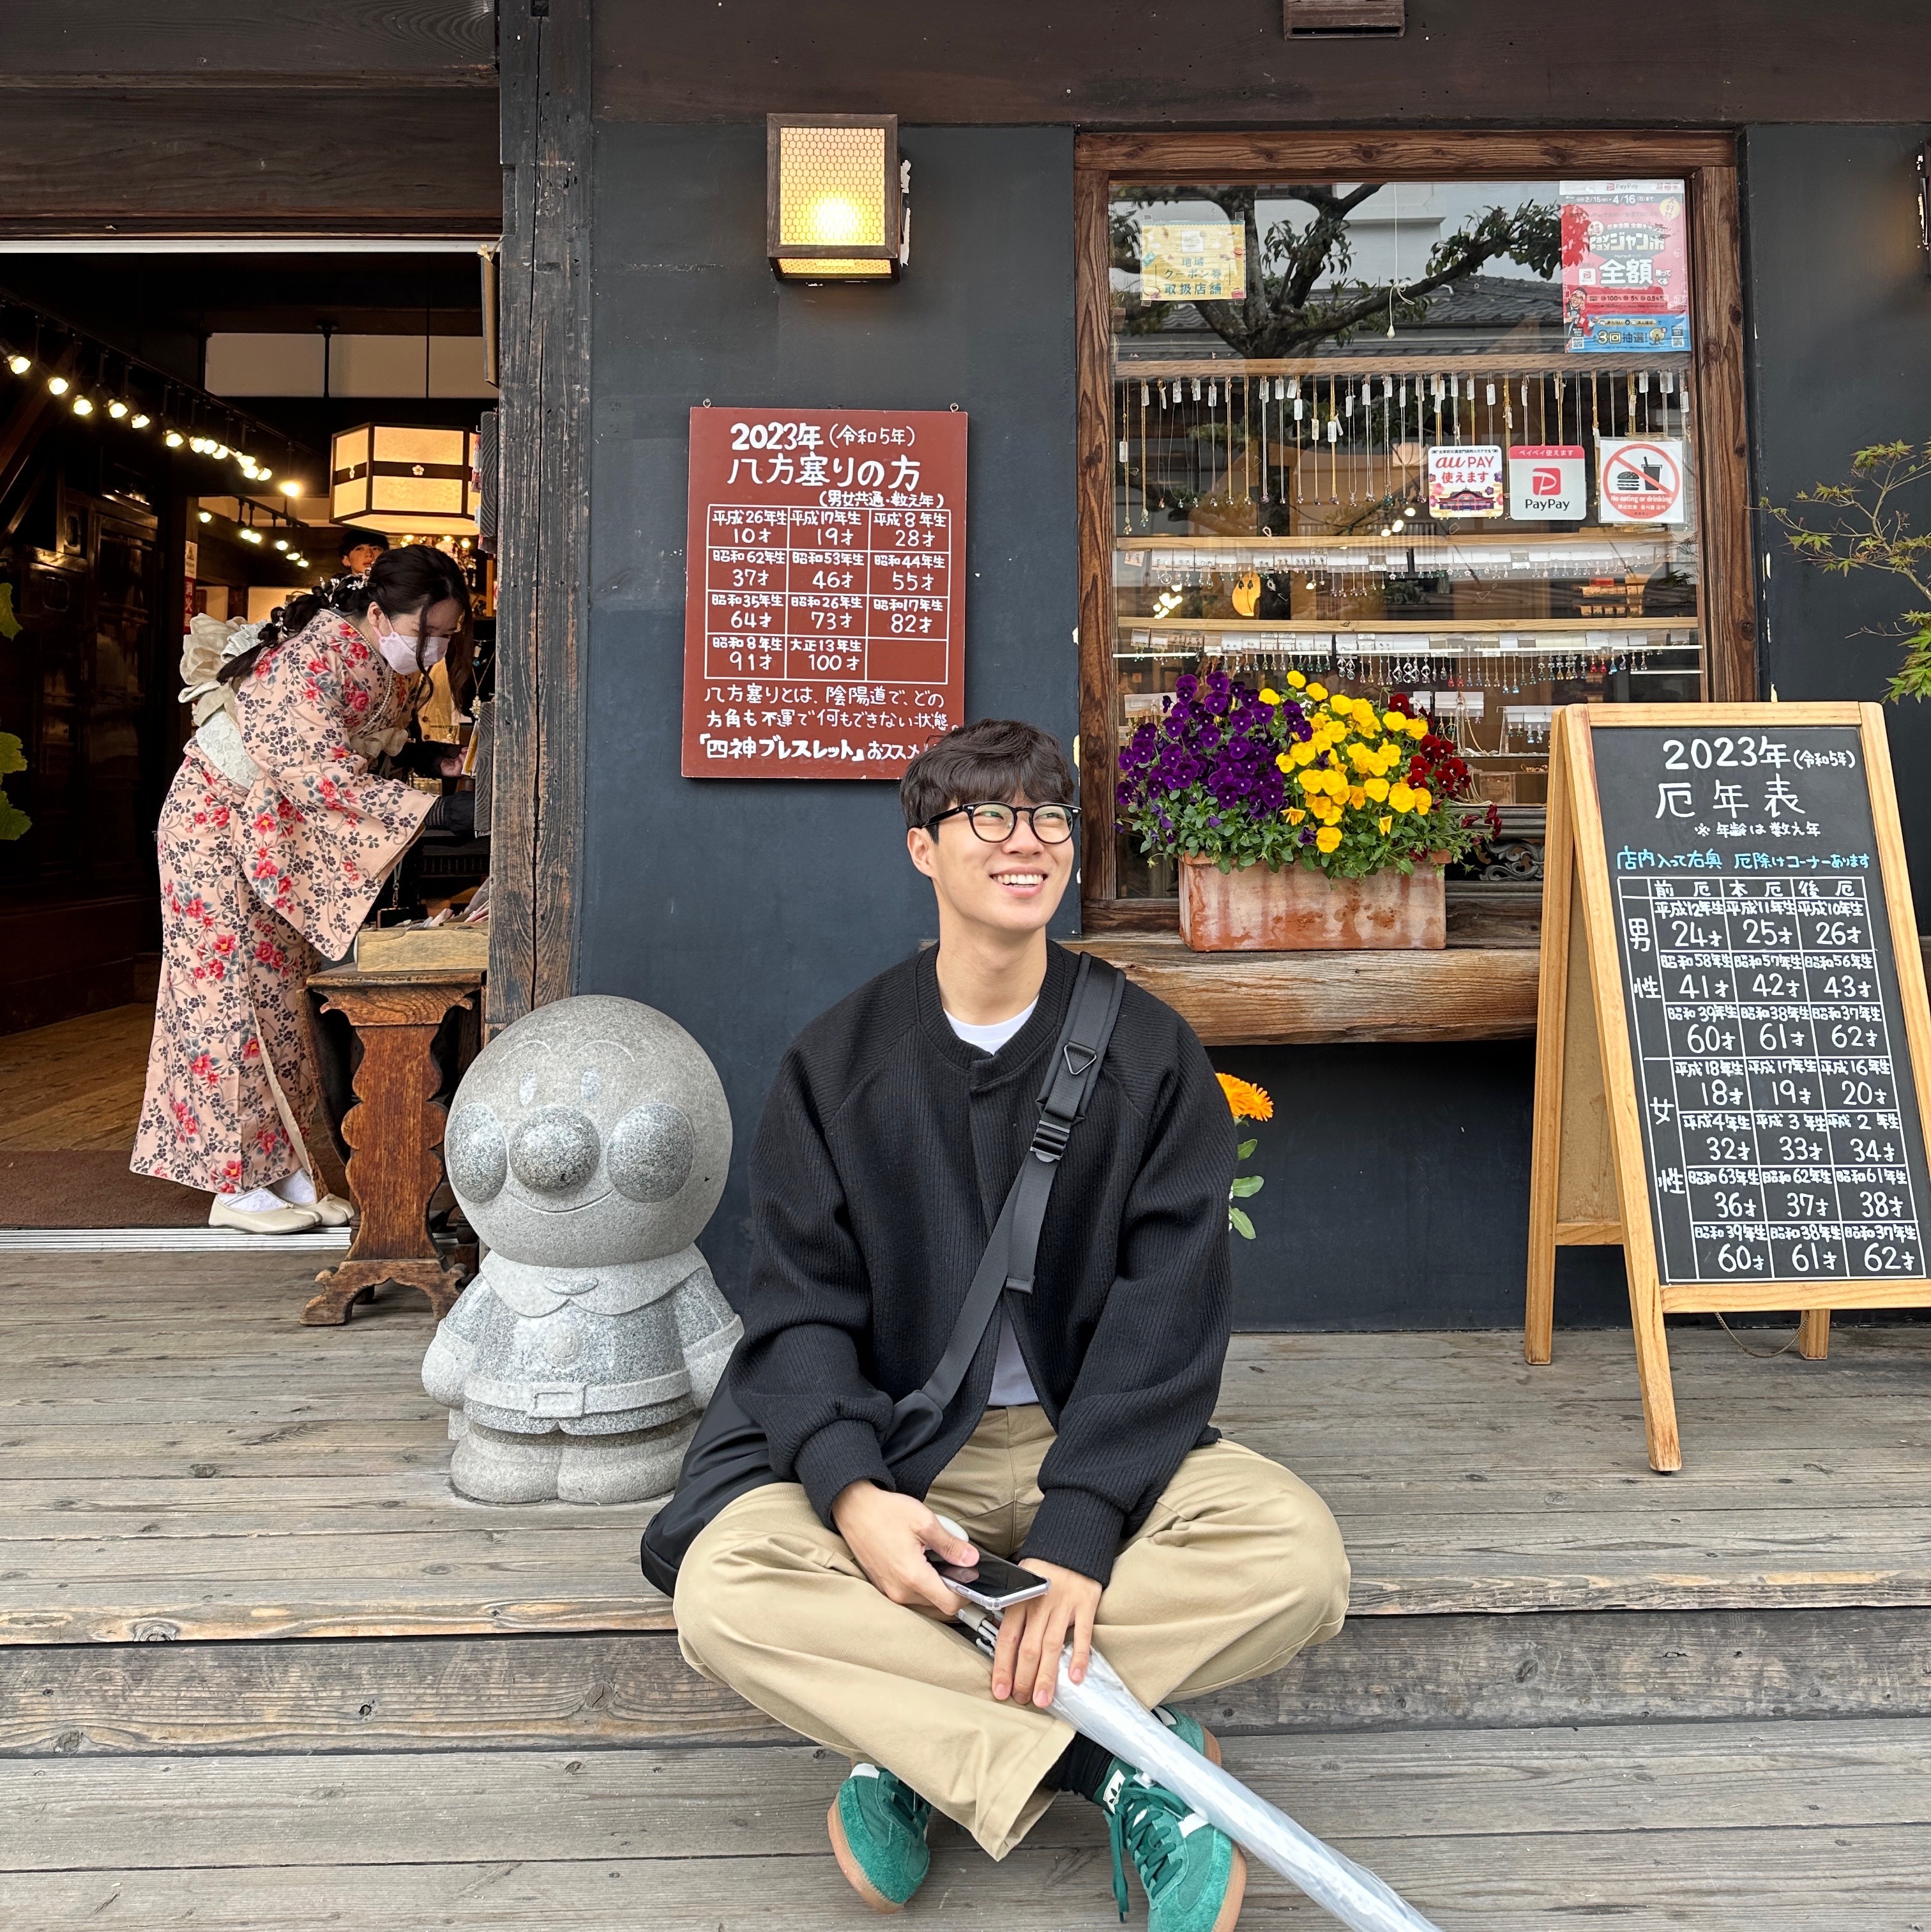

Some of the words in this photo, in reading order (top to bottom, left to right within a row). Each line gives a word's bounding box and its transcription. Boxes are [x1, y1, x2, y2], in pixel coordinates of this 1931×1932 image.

[1182, 257, 1204, 267] 地域
[1600, 259, 1653, 284] 全額
[1165, 269, 1222, 279] クーポン券
[1165, 283, 1222, 295] 取扱店舗
[727, 451, 921, 492] 八方塞りの方
[1435, 457, 1465, 468] au
[1468, 456, 1494, 468] PAY
[1442, 471, 1488, 483] 使えます
[1526, 499, 1570, 511] PayPay
[1620, 495, 1639, 503] eating
[1647, 496, 1672, 504] drinking
[712, 510, 787, 527] 平成26年生
[790, 510, 861, 527] 平成17年生
[873, 512, 947, 528] 平成8年生
[734, 528, 771, 544] 10才
[817, 528, 854, 545] 19才
[895, 529, 935, 547] 28才
[713, 551, 786, 565] 昭和62年生
[792, 552, 865, 567] 昭和53年生
[874, 554, 945, 568] 昭和44年生
[732, 569, 769, 588] 37才
[812, 570, 853, 589] 46才
[892, 572, 934, 591] 55才
[711, 593, 784, 608] 昭和35年生
[791, 596, 863, 609] 昭和26年生
[873, 598, 944, 612] 昭和17年生
[731, 611, 772, 628] 64才
[811, 612, 853, 630] 73才
[890, 613, 932, 634] 82才
[712, 637, 783, 651] 昭和8年生
[789, 639, 862, 653] 大正13年生
[729, 651, 773, 671] 91才
[808, 654, 860, 671] 100才
[1655, 773, 1805, 819] 厄年表
[1617, 846, 1723, 870] 店内入って右奥
[1734, 851, 1870, 870] 厄除けコーナーあります
[1655, 900, 1724, 918] 平成12年生
[1725, 900, 1796, 916] 平成11年生
[1797, 901, 1864, 917] 平成10年生
[1671, 920, 1722, 948] 24才
[1742, 918, 1793, 946] 25才
[1815, 921, 1861, 945] 26才
[1660, 953, 1732, 970] 昭和58年生
[1734, 954, 1802, 970] 昭和57年生
[1804, 954, 1874, 970] 昭和56年生
[1679, 973, 1729, 1000] 41才
[1752, 973, 1800, 998] 42才
[1823, 975, 1872, 999] 43才
[1668, 1004, 1738, 1023] 昭和39年生
[1741, 1005, 1810, 1022] 昭和38年生
[1812, 1006, 1882, 1022] 昭和37年生
[1687, 1023, 1736, 1054] 60才
[1759, 1023, 1805, 1051] 61才
[1831, 1024, 1878, 1049] 62才
[1674, 1060, 1744, 1077] 平成18年生
[1748, 1059, 1817, 1076] 平成17年生
[1820, 1058, 1891, 1076] 平成16年生
[1701, 1079, 1744, 1107] 18才
[1772, 1079, 1811, 1106] 19才
[1841, 1080, 1887, 1106] 20才
[1683, 1113, 1752, 1132] 平成4年生
[1756, 1114, 1827, 1132] 平成3年生
[1827, 1113, 1899, 1130] 平成2年生
[1706, 1136, 1751, 1161] 32才
[1779, 1136, 1823, 1161] 33才
[1849, 1138, 1895, 1163] 34才
[1688, 1168, 1761, 1186] 昭和63年生
[1762, 1168, 1832, 1185] 昭和62年生
[1836, 1168, 1907, 1185] 昭和61年生
[1714, 1191, 1757, 1219] 36才
[1787, 1192, 1829, 1218] 37才
[1859, 1191, 1903, 1219] 38才
[1695, 1224, 1768, 1242] 昭和39年生
[1770, 1224, 1842, 1242] 昭和38年生
[1845, 1224, 1916, 1242] 昭和37年生
[1718, 1244, 1764, 1272] 60才
[1792, 1242, 1838, 1272] 61才
[1864, 1242, 1914, 1272] 62才
